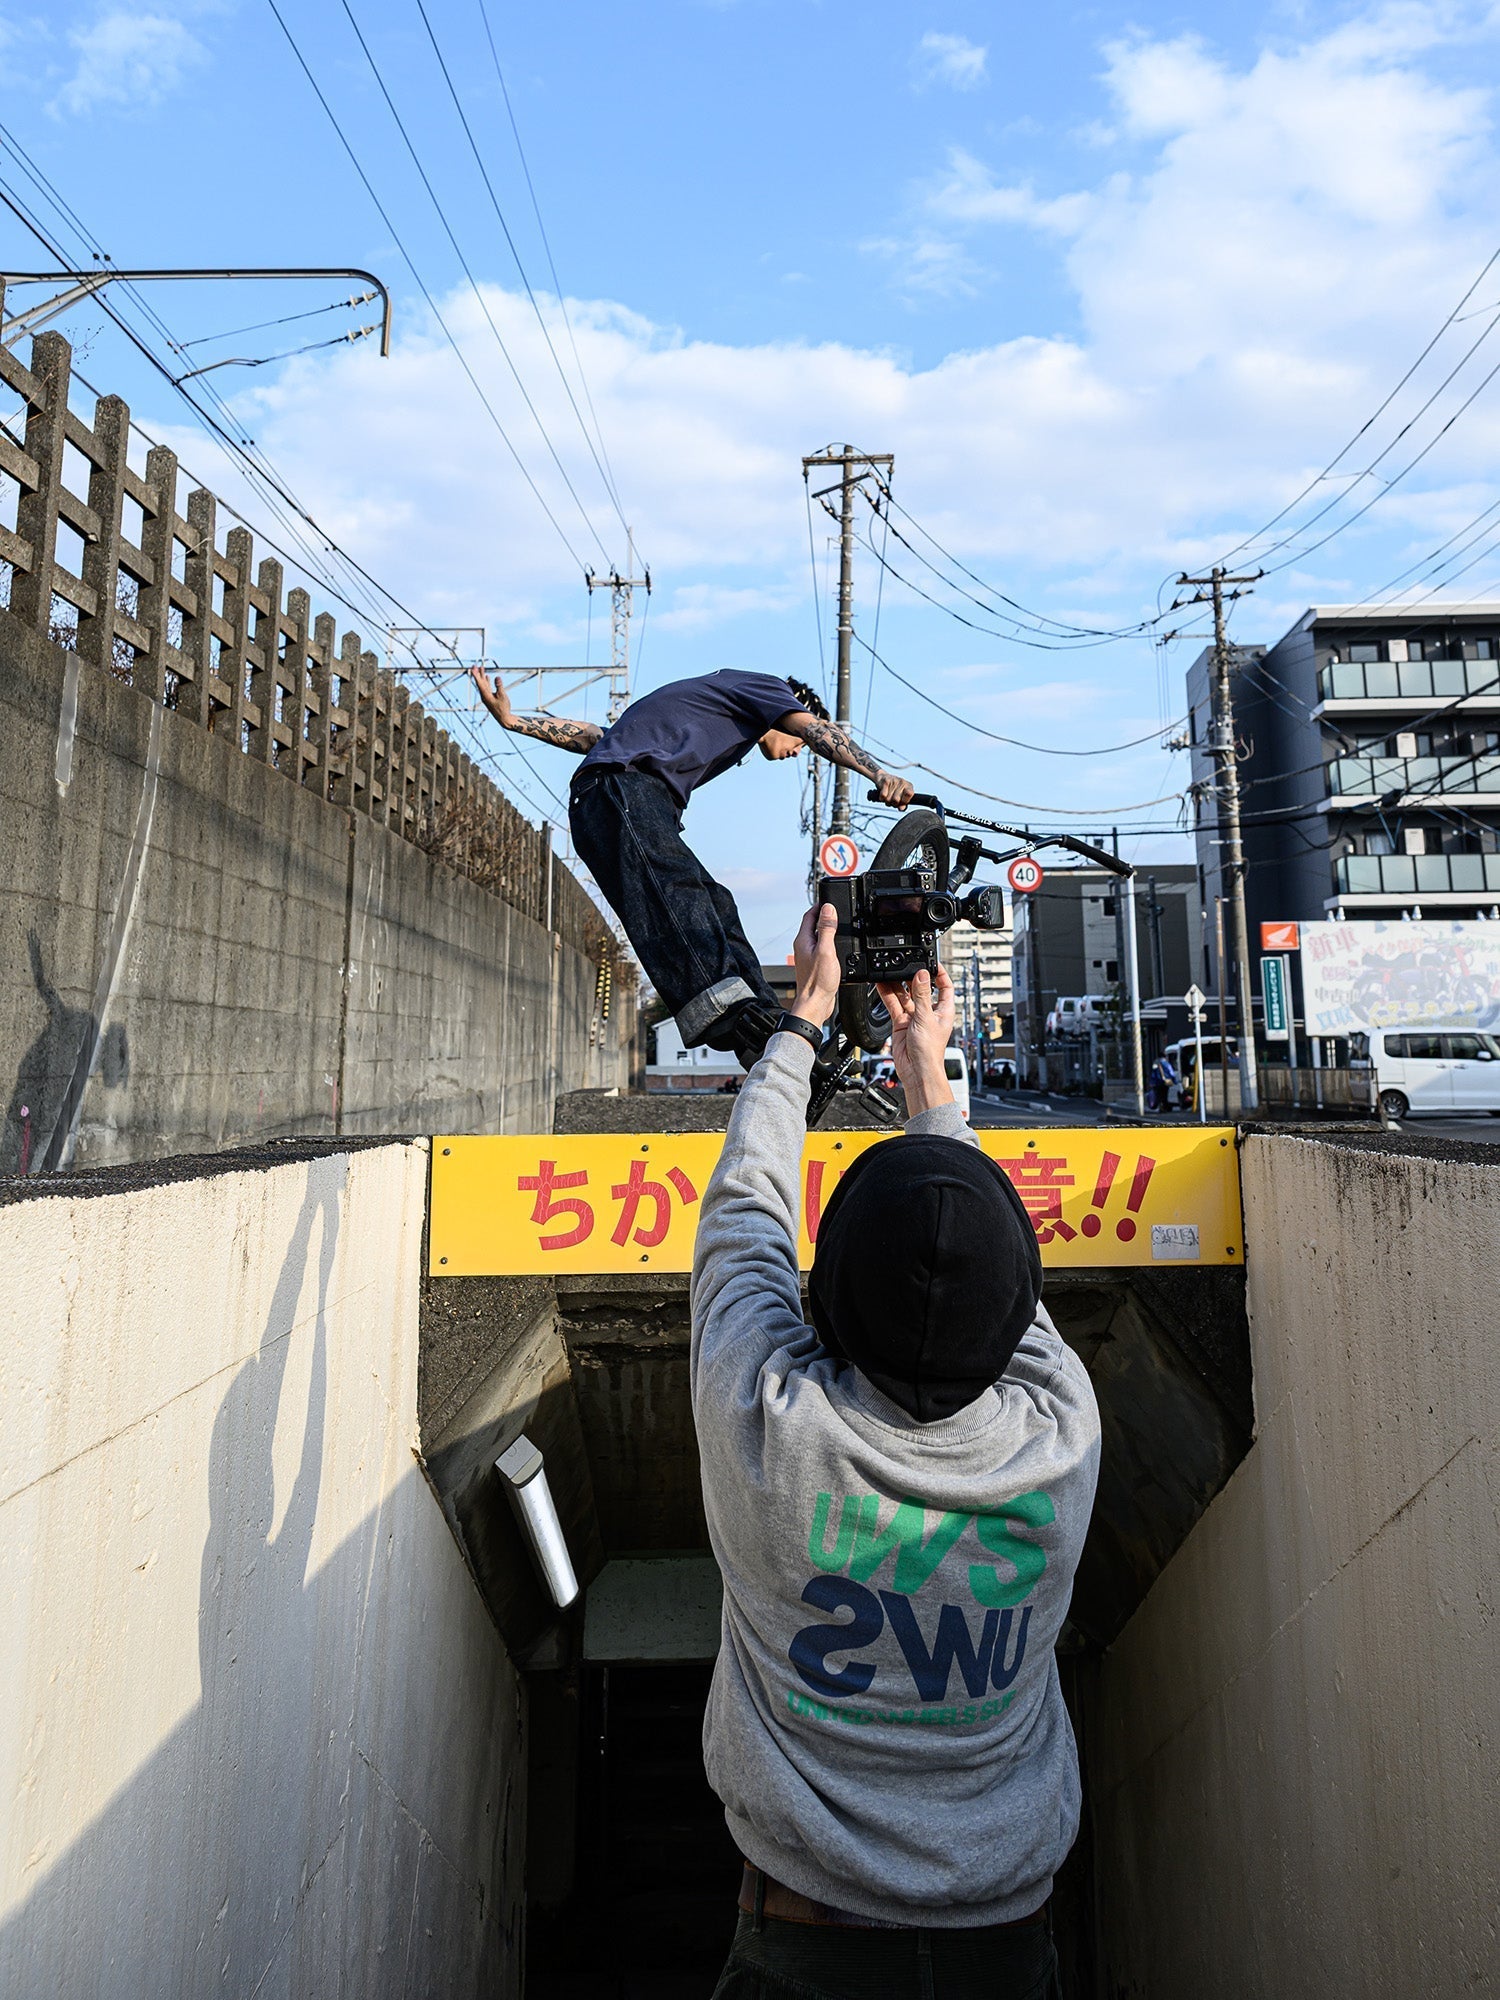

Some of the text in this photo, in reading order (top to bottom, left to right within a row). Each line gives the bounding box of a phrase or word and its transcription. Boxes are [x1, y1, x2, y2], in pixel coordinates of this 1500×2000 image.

[1015, 867, 1035, 882] 40
[808, 1490, 1056, 1609] UWS
[787, 1689, 874, 1725] UNITED
